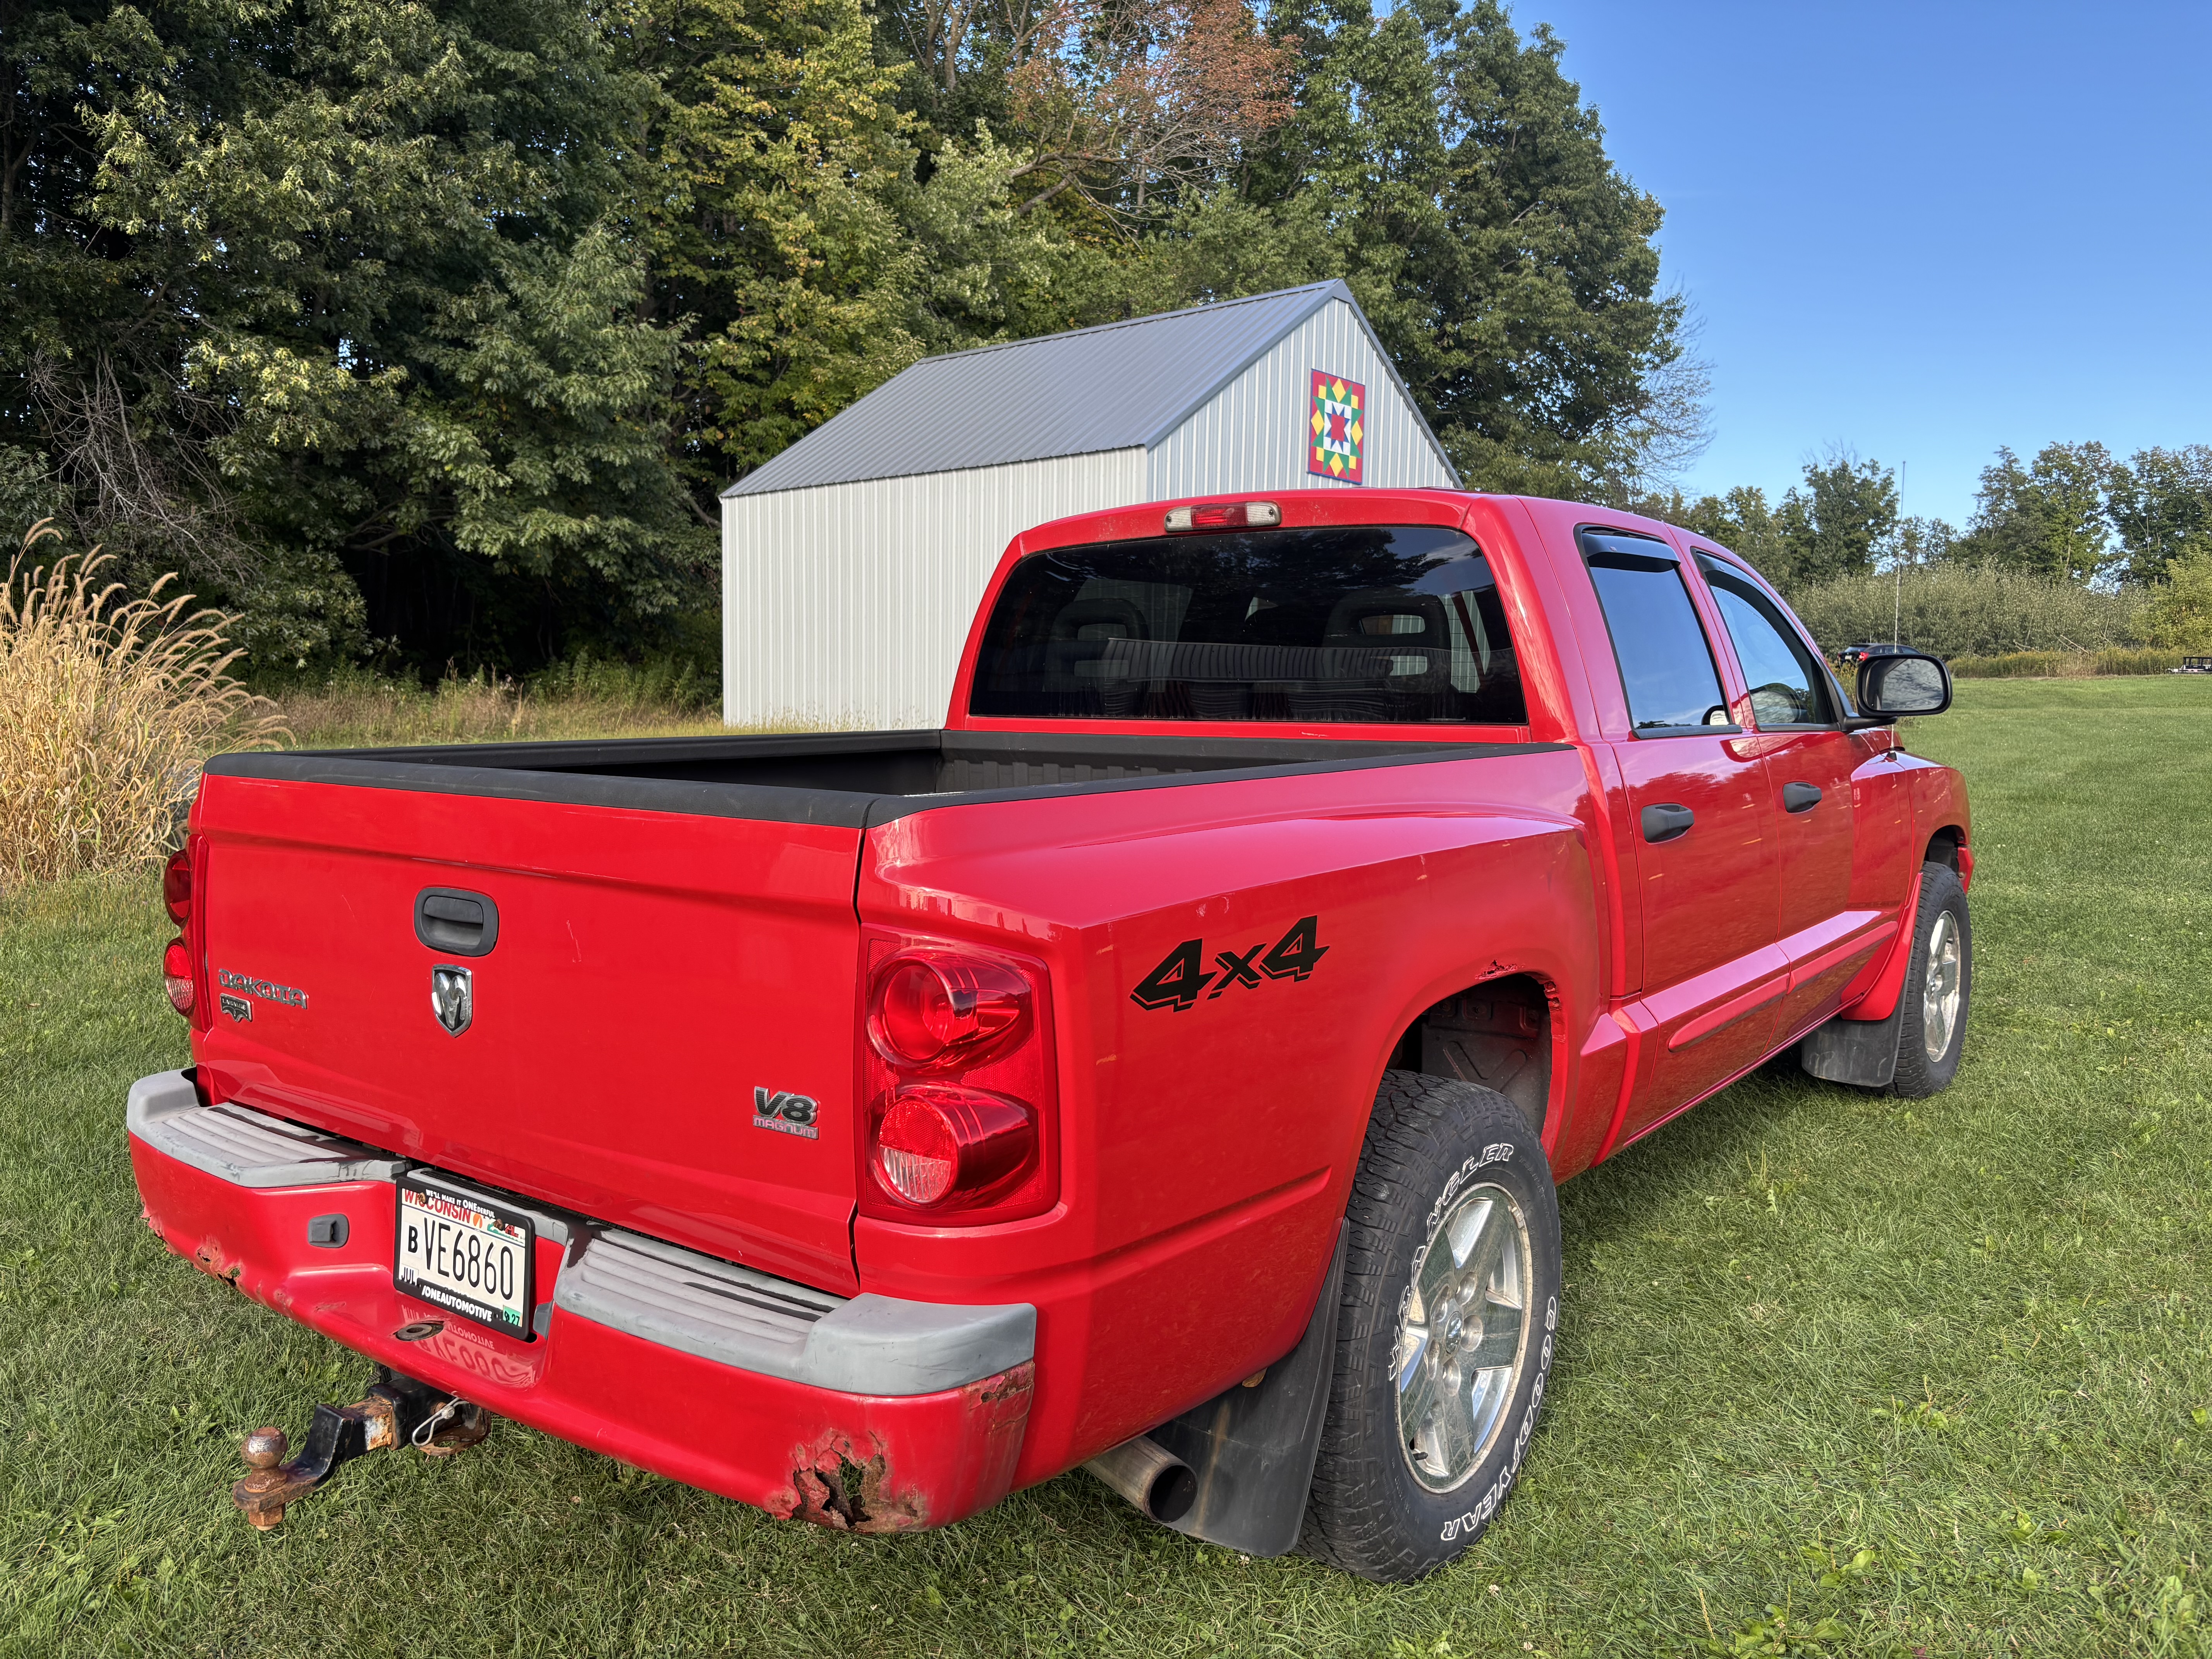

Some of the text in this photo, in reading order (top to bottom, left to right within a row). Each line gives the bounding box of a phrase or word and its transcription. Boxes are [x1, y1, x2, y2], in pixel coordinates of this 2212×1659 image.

[219, 969, 309, 1009] DAKOTA
[754, 1086, 817, 1126] V8
[755, 1118, 816, 1137] MAGNUM
[426, 1189, 440, 1199] WE'LL
[441, 1194, 455, 1204] MAKE
[408, 1217, 513, 1300] B VE6860
[512, 1314, 520, 1326] 27
[1441, 1296, 1557, 1541] GOODYEAR
